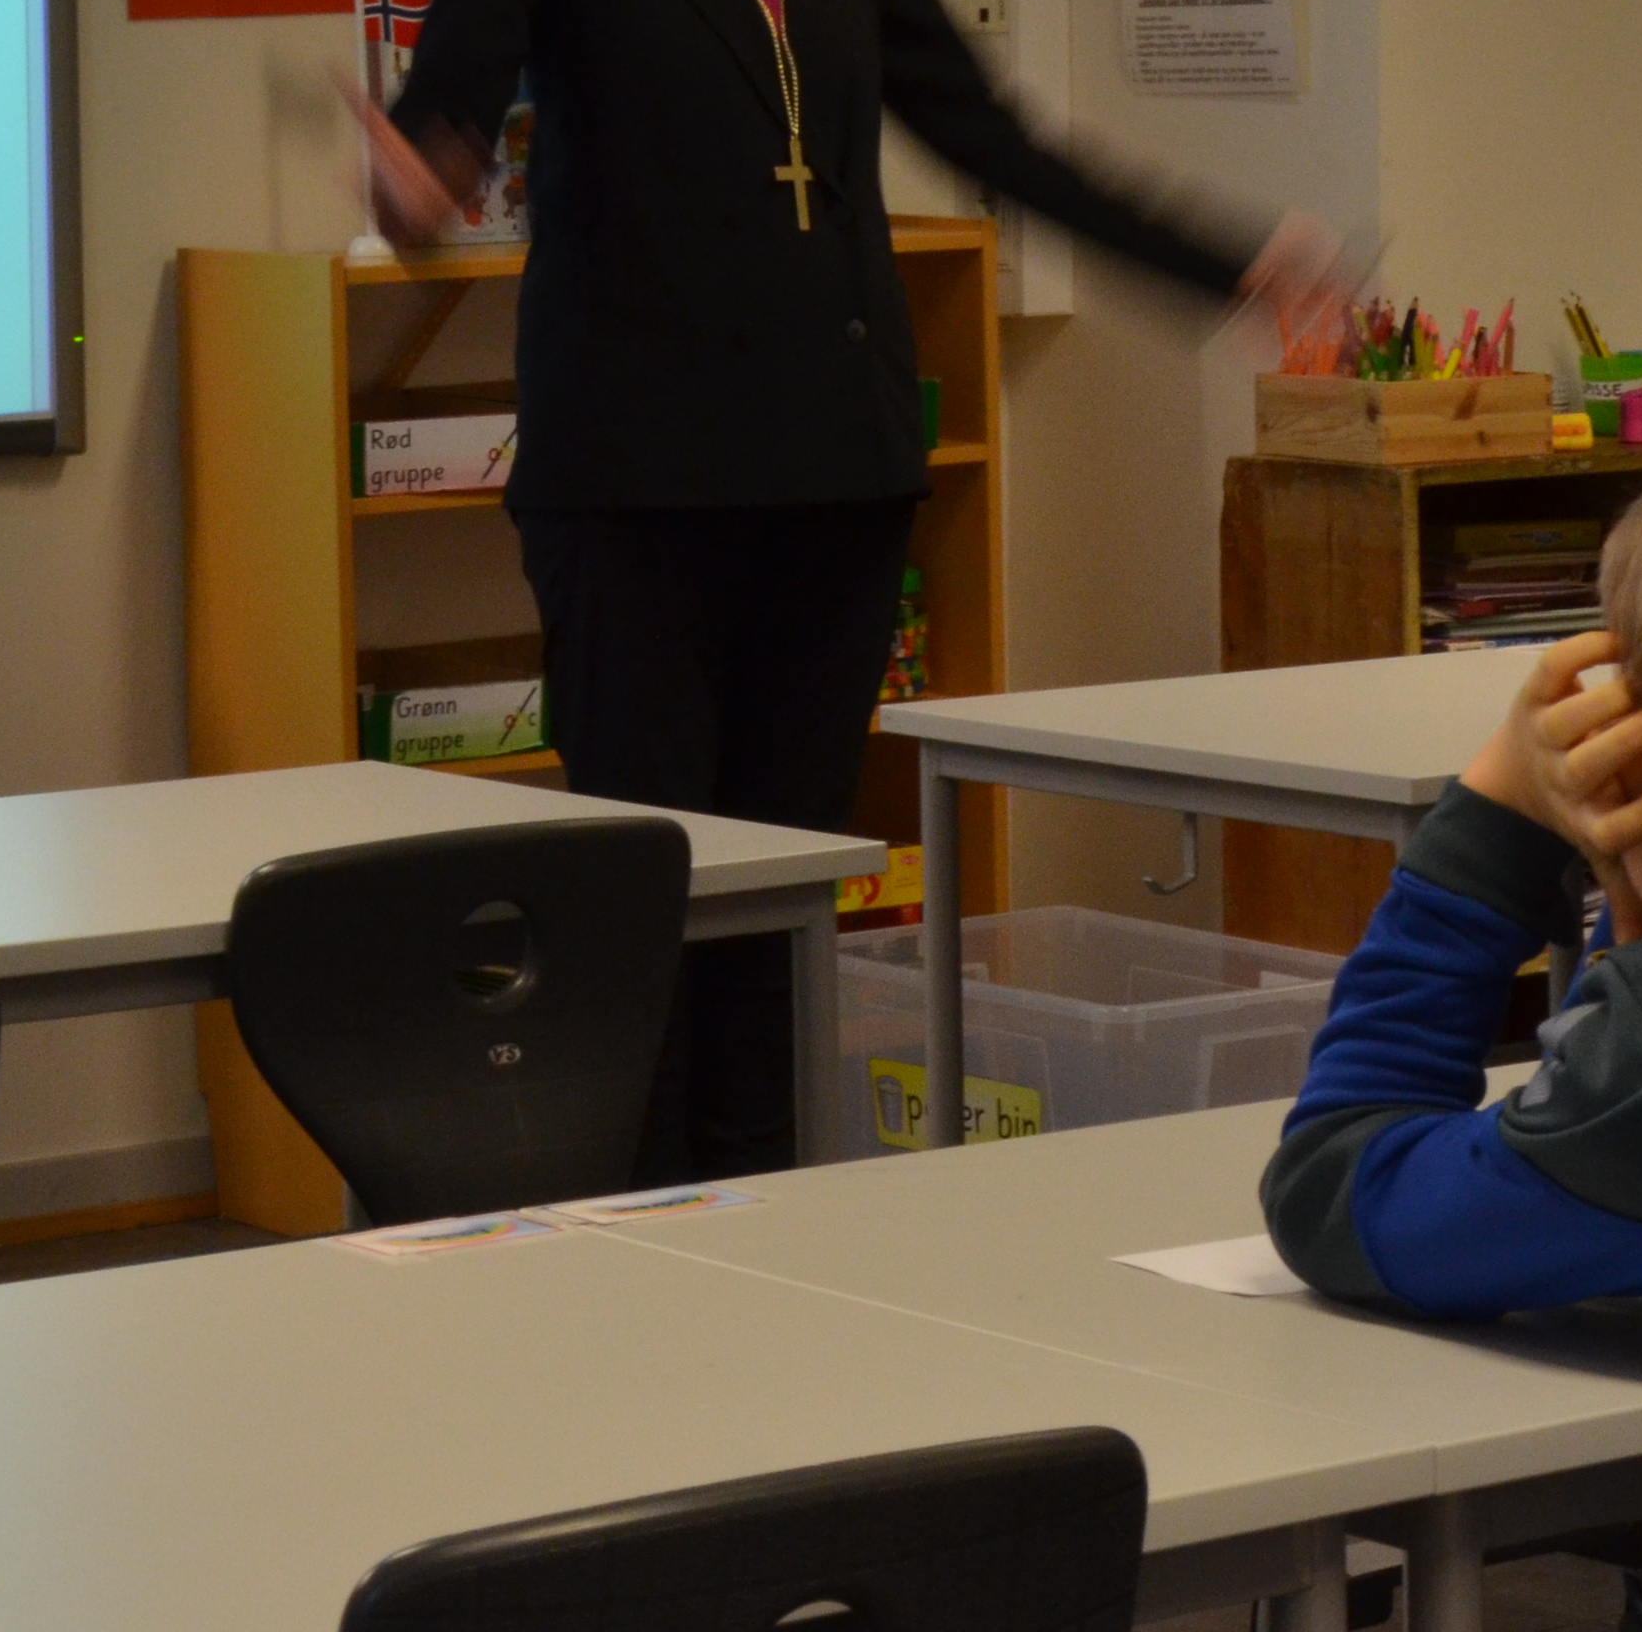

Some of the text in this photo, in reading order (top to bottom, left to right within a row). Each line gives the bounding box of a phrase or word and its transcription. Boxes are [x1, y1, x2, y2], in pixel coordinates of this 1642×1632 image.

[370, 428, 412, 452] Rød
[370, 463, 445, 489] gruppe
[397, 694, 458, 720] Grønn
[396, 729, 464, 756] gruppe
[906, 1093, 1038, 1139] per bin
